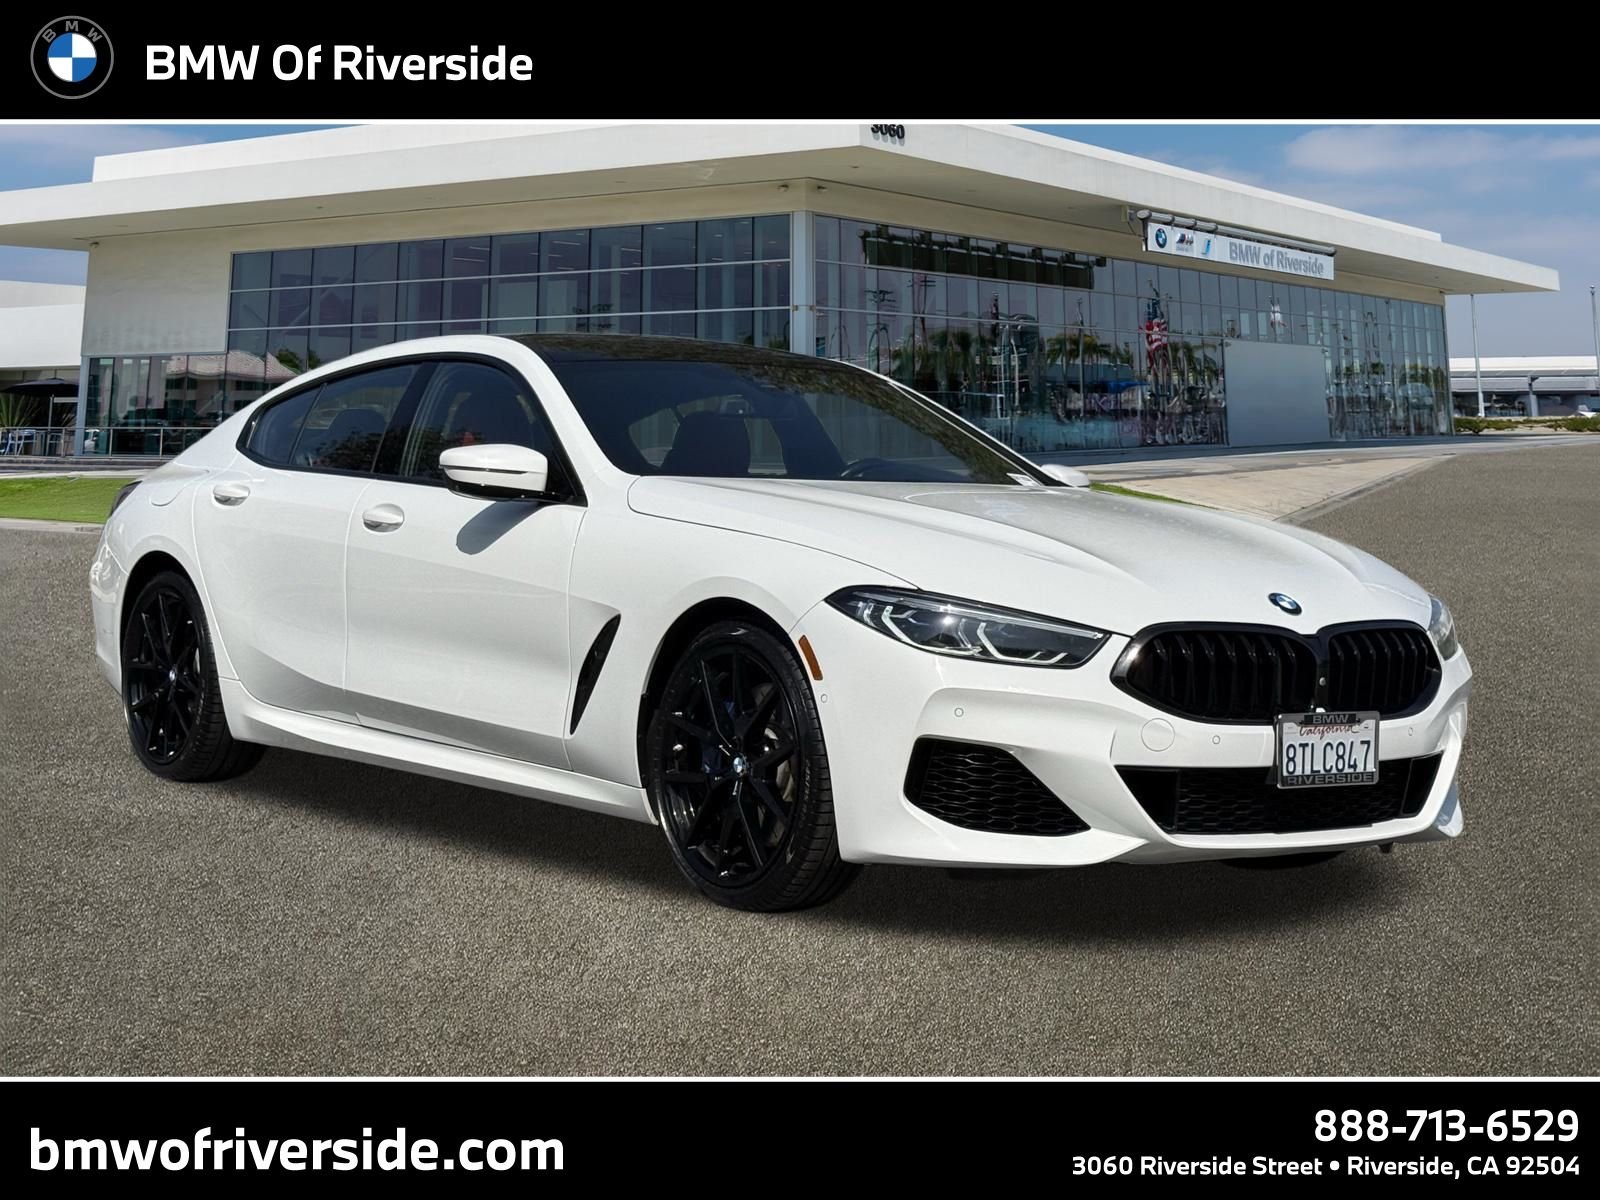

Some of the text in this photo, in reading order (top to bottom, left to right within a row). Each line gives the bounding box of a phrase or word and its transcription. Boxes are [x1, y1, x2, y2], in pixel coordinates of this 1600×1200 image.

[1229, 241, 1261, 265] BMW
[1263, 249, 1275, 267] of
[1277, 250, 1324, 275] Riverside
[1313, 714, 1349, 724] BMW
[1286, 740, 1371, 775] 8TLC847
[1287, 772, 1373, 785] RIVERSIDE
